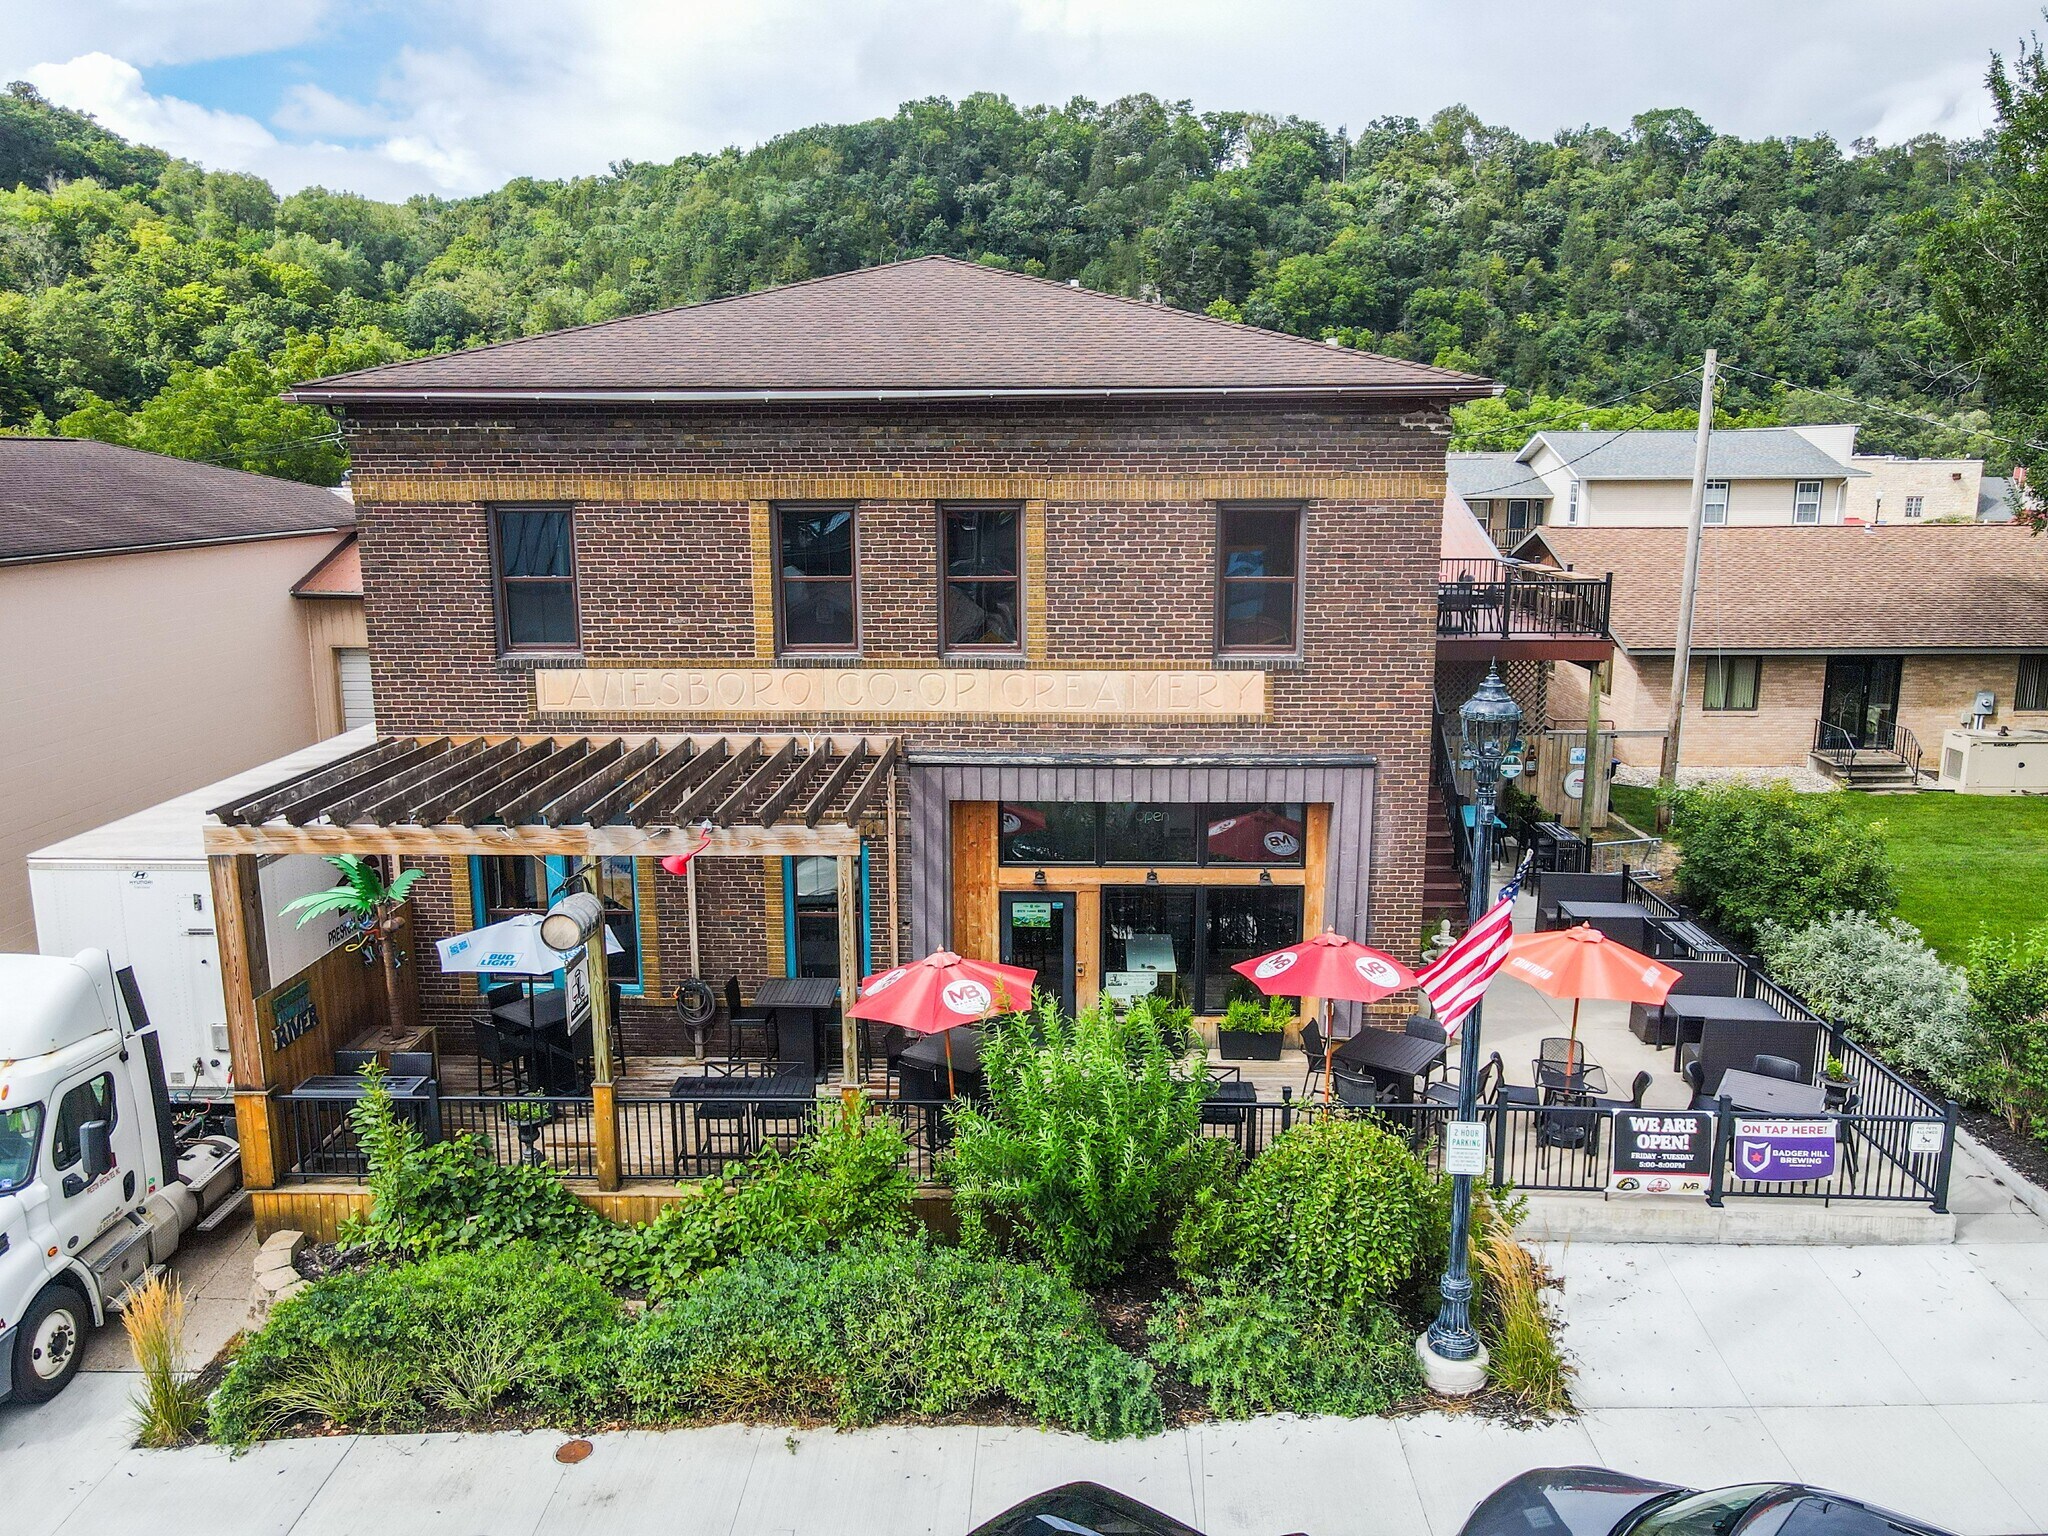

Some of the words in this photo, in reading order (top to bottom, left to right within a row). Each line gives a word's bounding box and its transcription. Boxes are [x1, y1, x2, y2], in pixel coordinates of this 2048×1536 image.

[540, 671, 812, 708] LANESBORO
[836, 672, 978, 709] CO-OP
[1001, 673, 1258, 711] CREAMERY
[488, 953, 516, 961] BUD
[480, 959, 518, 967] LIGHT
[1358, 961, 1388, 977] MB
[947, 984, 981, 1003] MB
[1628, 1116, 1661, 1133] WE
[1660, 1117, 1698, 1134] ARE
[1742, 1124, 1761, 1134] ON
[1764, 1125, 1788, 1135] TAP
[1791, 1125, 1828, 1135] HERE!
[1460, 1129, 1480, 1137] HOUR
[1452, 1138, 1481, 1148] PARKING
[1636, 1133, 1690, 1151] OPEN!
[1630, 1152, 1657, 1160] FRIDAY
[1661, 1153, 1695, 1161] TUESDAY
[1772, 1149, 1810, 1157] BADGER
